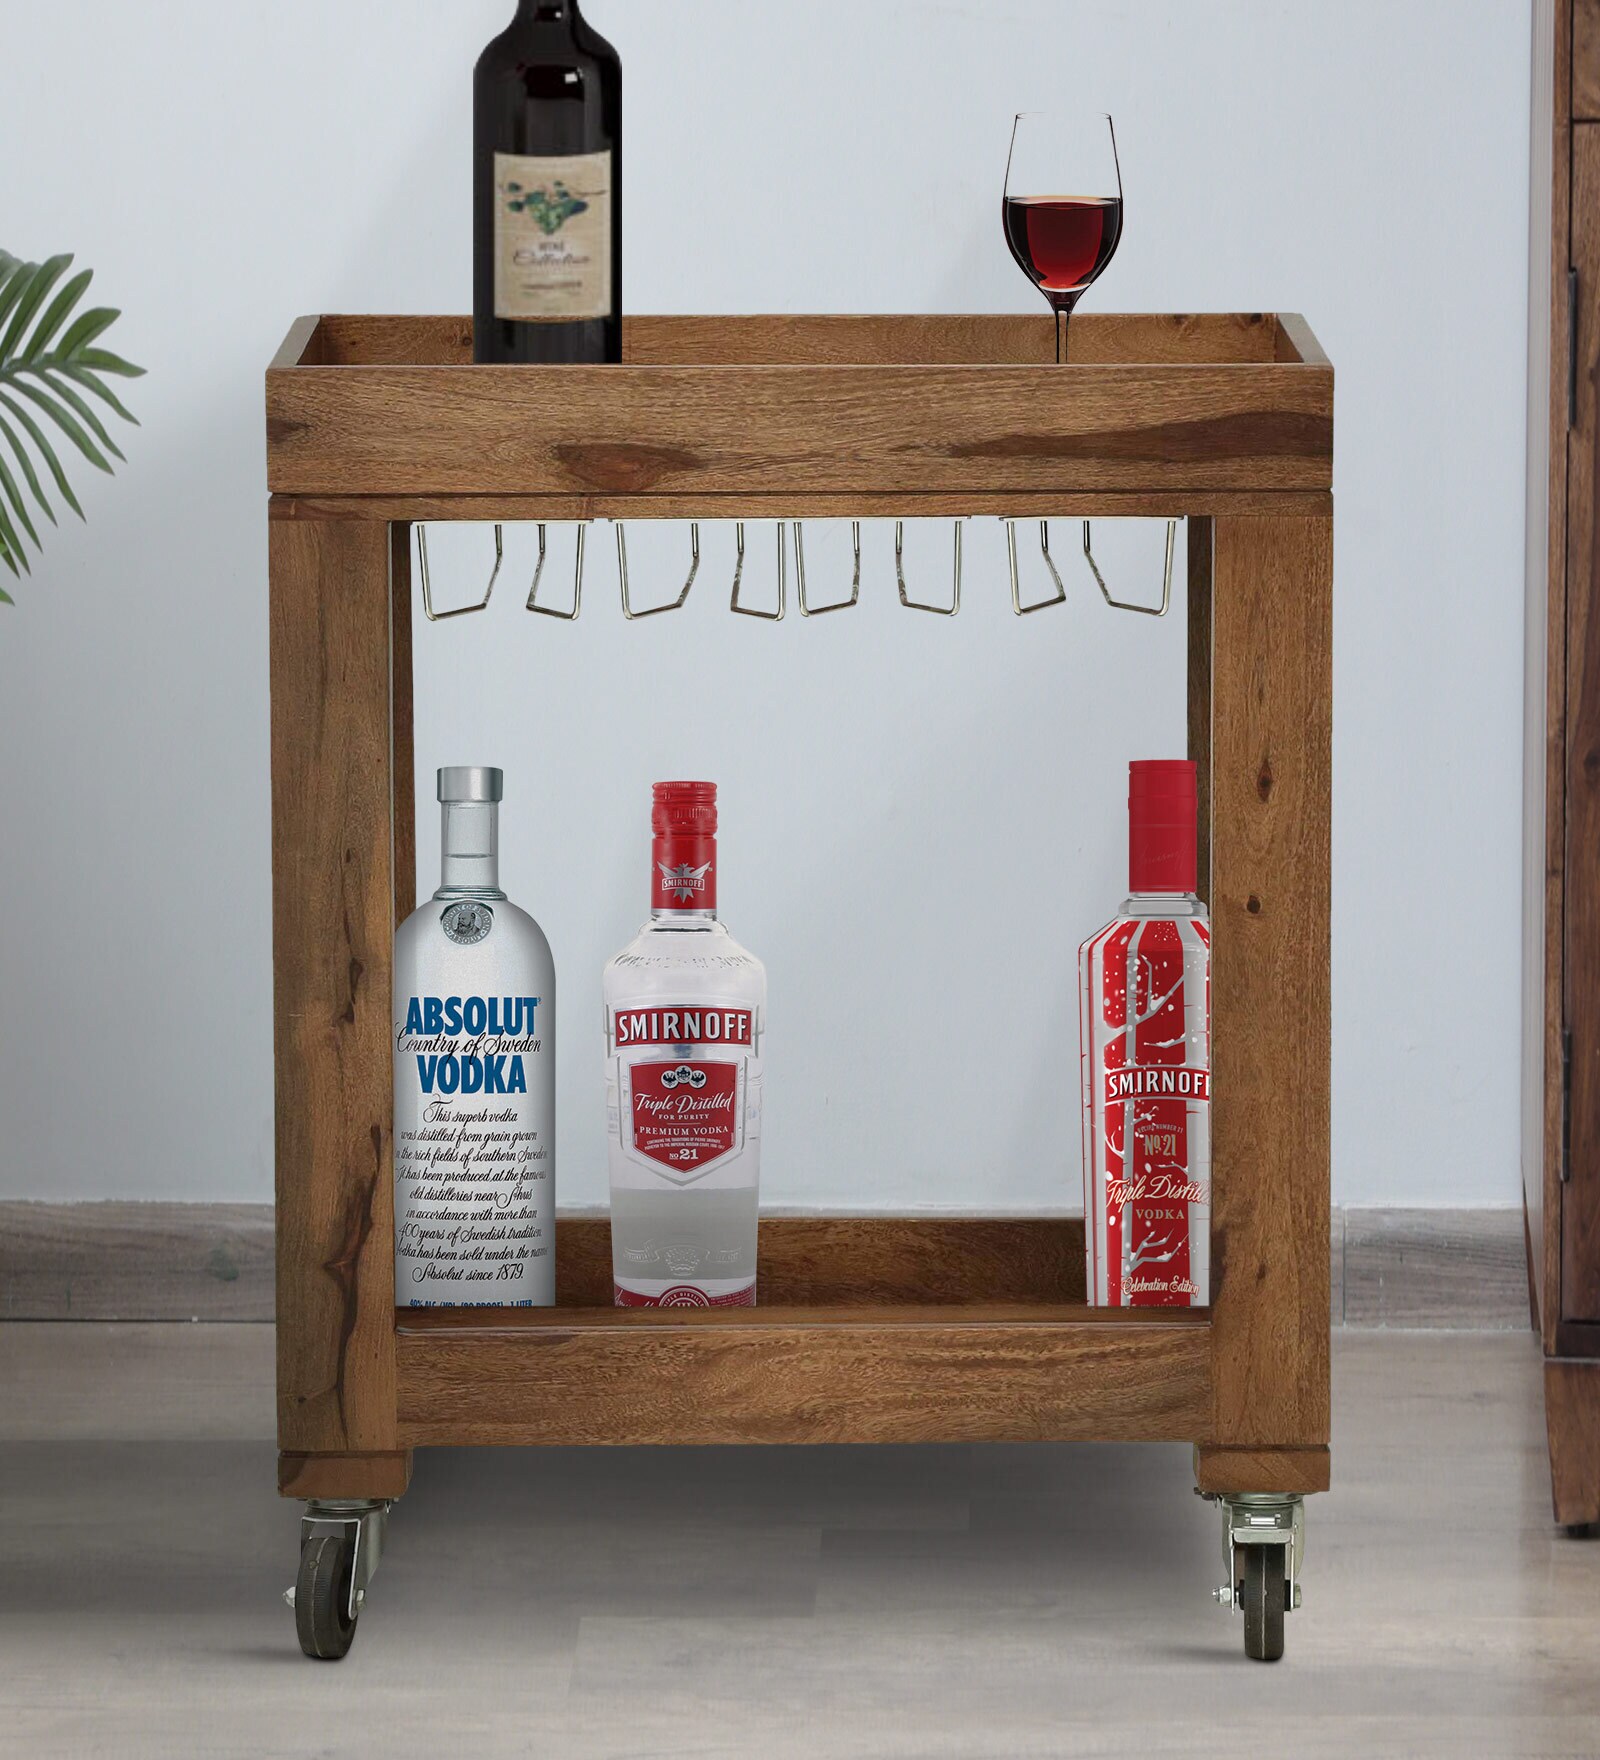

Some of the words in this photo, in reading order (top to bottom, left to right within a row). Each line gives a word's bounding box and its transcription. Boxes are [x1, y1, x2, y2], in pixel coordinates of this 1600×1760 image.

[664, 879, 703, 889] SMIRNOFF
[406, 996, 538, 1036] ABSOLUT
[619, 1012, 747, 1042] SMIRNOFF
[395, 1022, 460, 1062] Country
[463, 1032, 485, 1065] of
[483, 1028, 541, 1058] Sweden
[417, 1055, 527, 1094] VODKA
[423, 1093, 453, 1123] This
[452, 1108, 488, 1127] superb
[489, 1108, 518, 1122] vodka
[634, 1093, 673, 1115] Triple
[675, 1091, 735, 1113] Distilled
[401, 1130, 417, 1140] was
[417, 1127, 457, 1141] distilled
[455, 1128, 482, 1148] from
[480, 1131, 511, 1150] grain
[509, 1131, 538, 1150] grown
[639, 1126, 690, 1135] PREMIUM
[693, 1126, 729, 1134] VODKA
[401, 1146, 413, 1159] the
[414, 1147, 431, 1159] rich
[431, 1147, 458, 1168] fields
[461, 1147, 475, 1169] of
[473, 1147, 516, 1161] southern
[406, 1166, 420, 1180] has
[422, 1167, 443, 1181] been
[442, 1168, 492, 1186] produced
[490, 1170, 504, 1182] at
[504, 1167, 519, 1181] the
[410, 1186, 425, 1199] old
[424, 1187, 474, 1201] distilleries
[474, 1191, 498, 1201] near
[1106, 1175, 1147, 1212] Triple
[406, 1208, 415, 1218] in
[416, 1207, 469, 1220] accordance
[470, 1207, 493, 1220] with
[494, 1210, 518, 1220] more
[518, 1205, 537, 1219] than
[1136, 1209, 1185, 1220] VODKA
[399, 1222, 420, 1238] 400
[418, 1229, 445, 1246] years
[446, 1226, 461, 1247] of
[461, 1225, 507, 1243] Swedish
[417, 1244, 434, 1259] has
[435, 1246, 458, 1260] been
[460, 1246, 485, 1260] sold
[484, 1246, 514, 1260] under
[516, 1244, 530, 1258] the
[412, 1262, 464, 1283] Absolut
[465, 1269, 493, 1280] since
[495, 1263, 524, 1280] 1879.
[1121, 1277, 1168, 1295] Celebration
[1169, 1275, 1199, 1297] Edition
